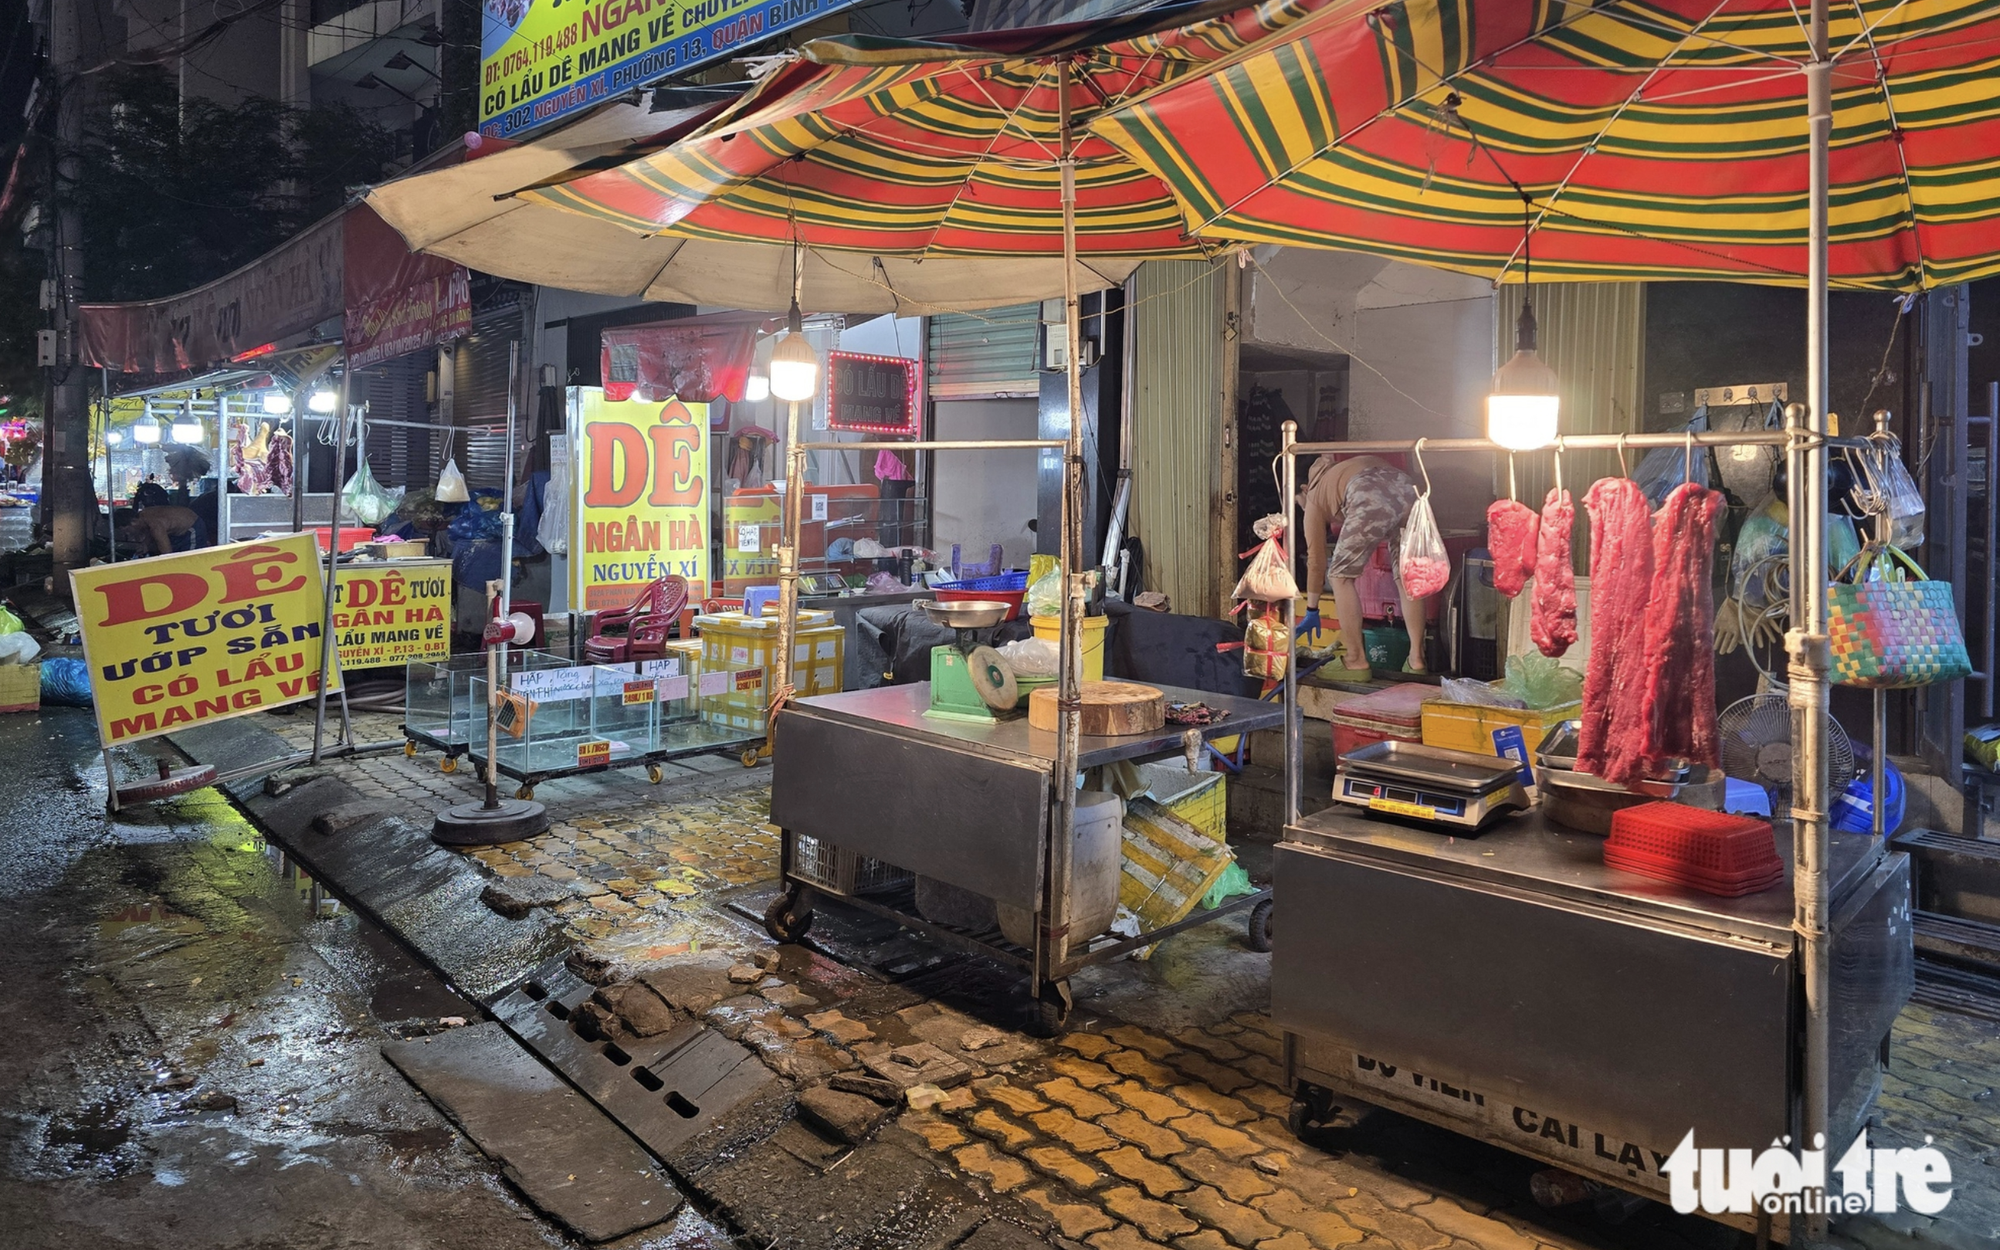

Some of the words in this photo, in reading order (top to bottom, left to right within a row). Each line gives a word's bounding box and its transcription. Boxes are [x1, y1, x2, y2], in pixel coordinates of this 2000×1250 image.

[484, 86, 506, 116] CÓ
[511, 68, 543, 105] LẨU
[549, 55, 572, 88] DÊ
[579, 28, 640, 75] MANG
[648, 4, 675, 43] VỀ
[485, 61, 500, 87] ĐT:
[503, 22, 577, 78] 0764.119.488
[505, 106, 531, 132] 302
[534, 83, 586, 120] NGUYỄN
[590, 73, 608, 101] XÍ,
[612, 52, 676, 90] PHƯỜNG
[681, 38, 707, 62] 13,
[712, 11, 763, 50] QUẬN
[833, 364, 854, 395] CÓ
[858, 362, 887, 398] LẨU
[841, 404, 882, 423] MANG
[584, 399, 703, 508] DÊ
[586, 515, 660, 553] NGÂN
[669, 514, 703, 550] HÀ
[94, 545, 307, 627] DÊ
[593, 553, 671, 582] NGUYỄN
[679, 555, 698, 578] XÍ
[345, 569, 407, 608] DÊ
[410, 576, 445, 599] TƯƠI
[144, 603, 277, 645] TƯƠI
[405, 604, 445, 623] HÀ
[335, 629, 365, 646] LẨU
[371, 629, 419, 643] MANG
[425, 623, 443, 640] VỀ
[373, 645, 384, 655] XÍ
[394, 645, 414, 654] P.13
[424, 642, 446, 651] Q.BT
[102, 646, 207, 681] ƯỚP
[132, 673, 199, 705] CÓ
[216, 652, 304, 687] LẨU
[110, 689, 261, 739] MANG
